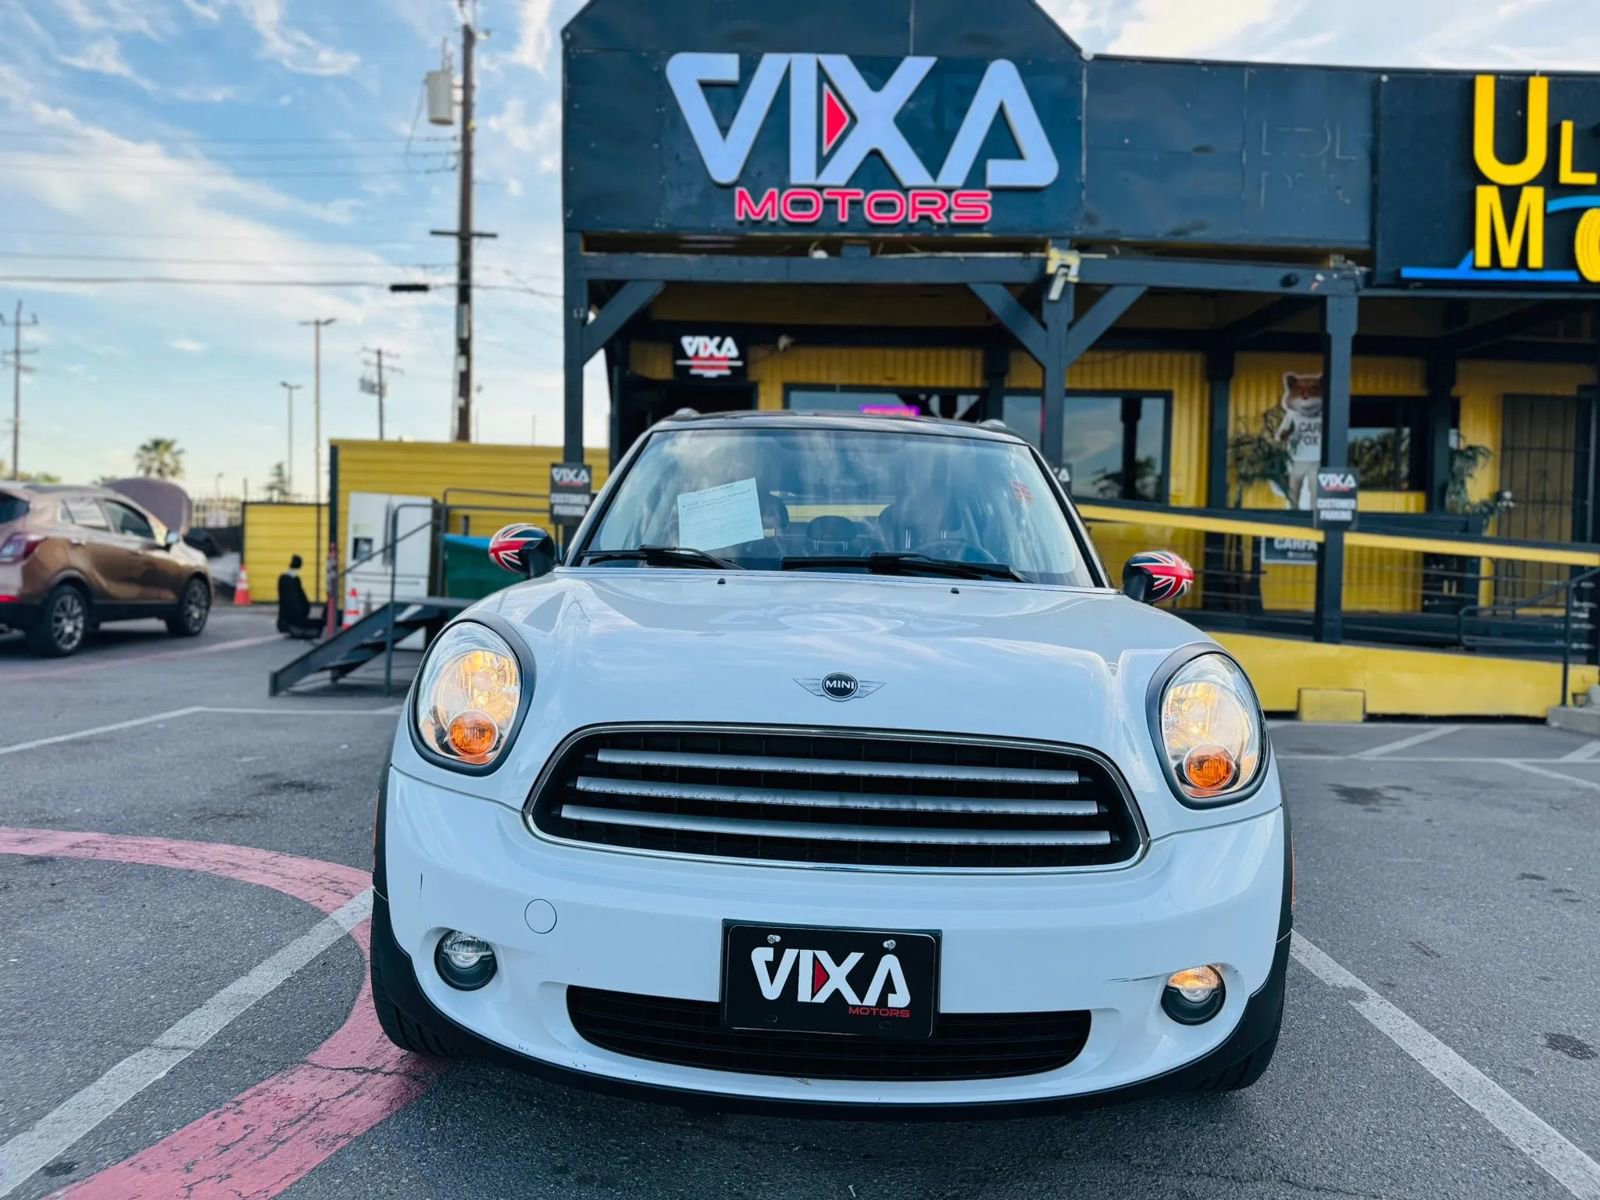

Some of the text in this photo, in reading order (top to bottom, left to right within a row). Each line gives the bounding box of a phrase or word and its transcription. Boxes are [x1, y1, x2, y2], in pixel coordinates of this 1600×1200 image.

[665, 52, 1059, 189] VIXA
[734, 187, 992, 224] MOTORS
[681, 336, 739, 358] VIXA
[551, 467, 590, 483] VIXA
[1318, 473, 1356, 488] VIXA
[825, 680, 855, 689] MINI
[751, 946, 911, 1008] VIXA
[848, 1006, 911, 1018] MOTORS
